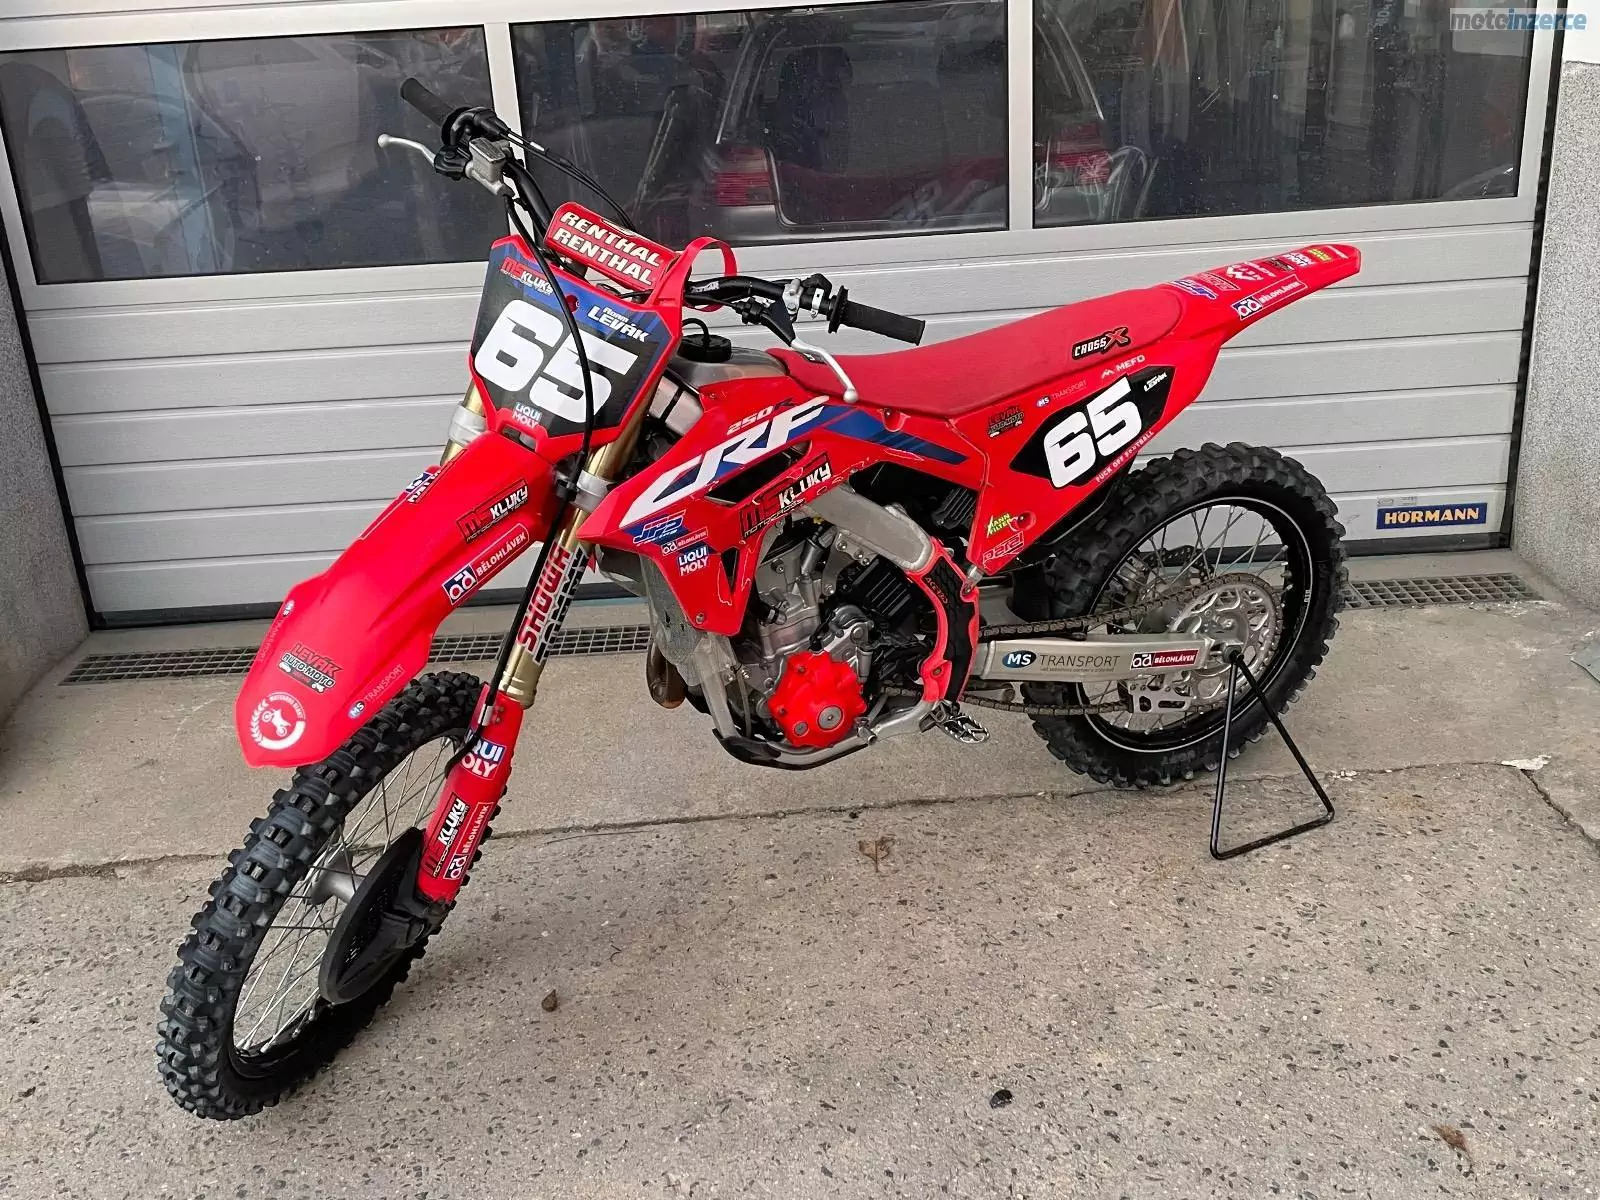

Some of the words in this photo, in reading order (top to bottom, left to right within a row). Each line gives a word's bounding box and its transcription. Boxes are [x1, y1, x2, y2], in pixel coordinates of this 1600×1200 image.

[553, 228, 652, 286] RENTHAL
[560, 211, 660, 267] RENTHAL
[587, 306, 649, 343] LEVÁK
[474, 299, 639, 425] 65
[1116, 354, 1146, 372] MEFO
[512, 411, 539, 430] MOLY
[516, 402, 542, 422] LIQUI
[1043, 376, 1143, 489] 65
[619, 396, 829, 529] CRF
[1384, 508, 1480, 525] HÖRMANN
[476, 532, 527, 577] BĚLOHLÁVEK
[679, 546, 708, 565] LIQUI
[680, 556, 708, 576] MOLY
[516, 541, 571, 653] SHOWA
[1007, 653, 1033, 666] MS
[1040, 654, 1121, 669] TRANSPORT
[365, 664, 404, 702] TRANSPORT
[461, 752, 498, 779] OLY
